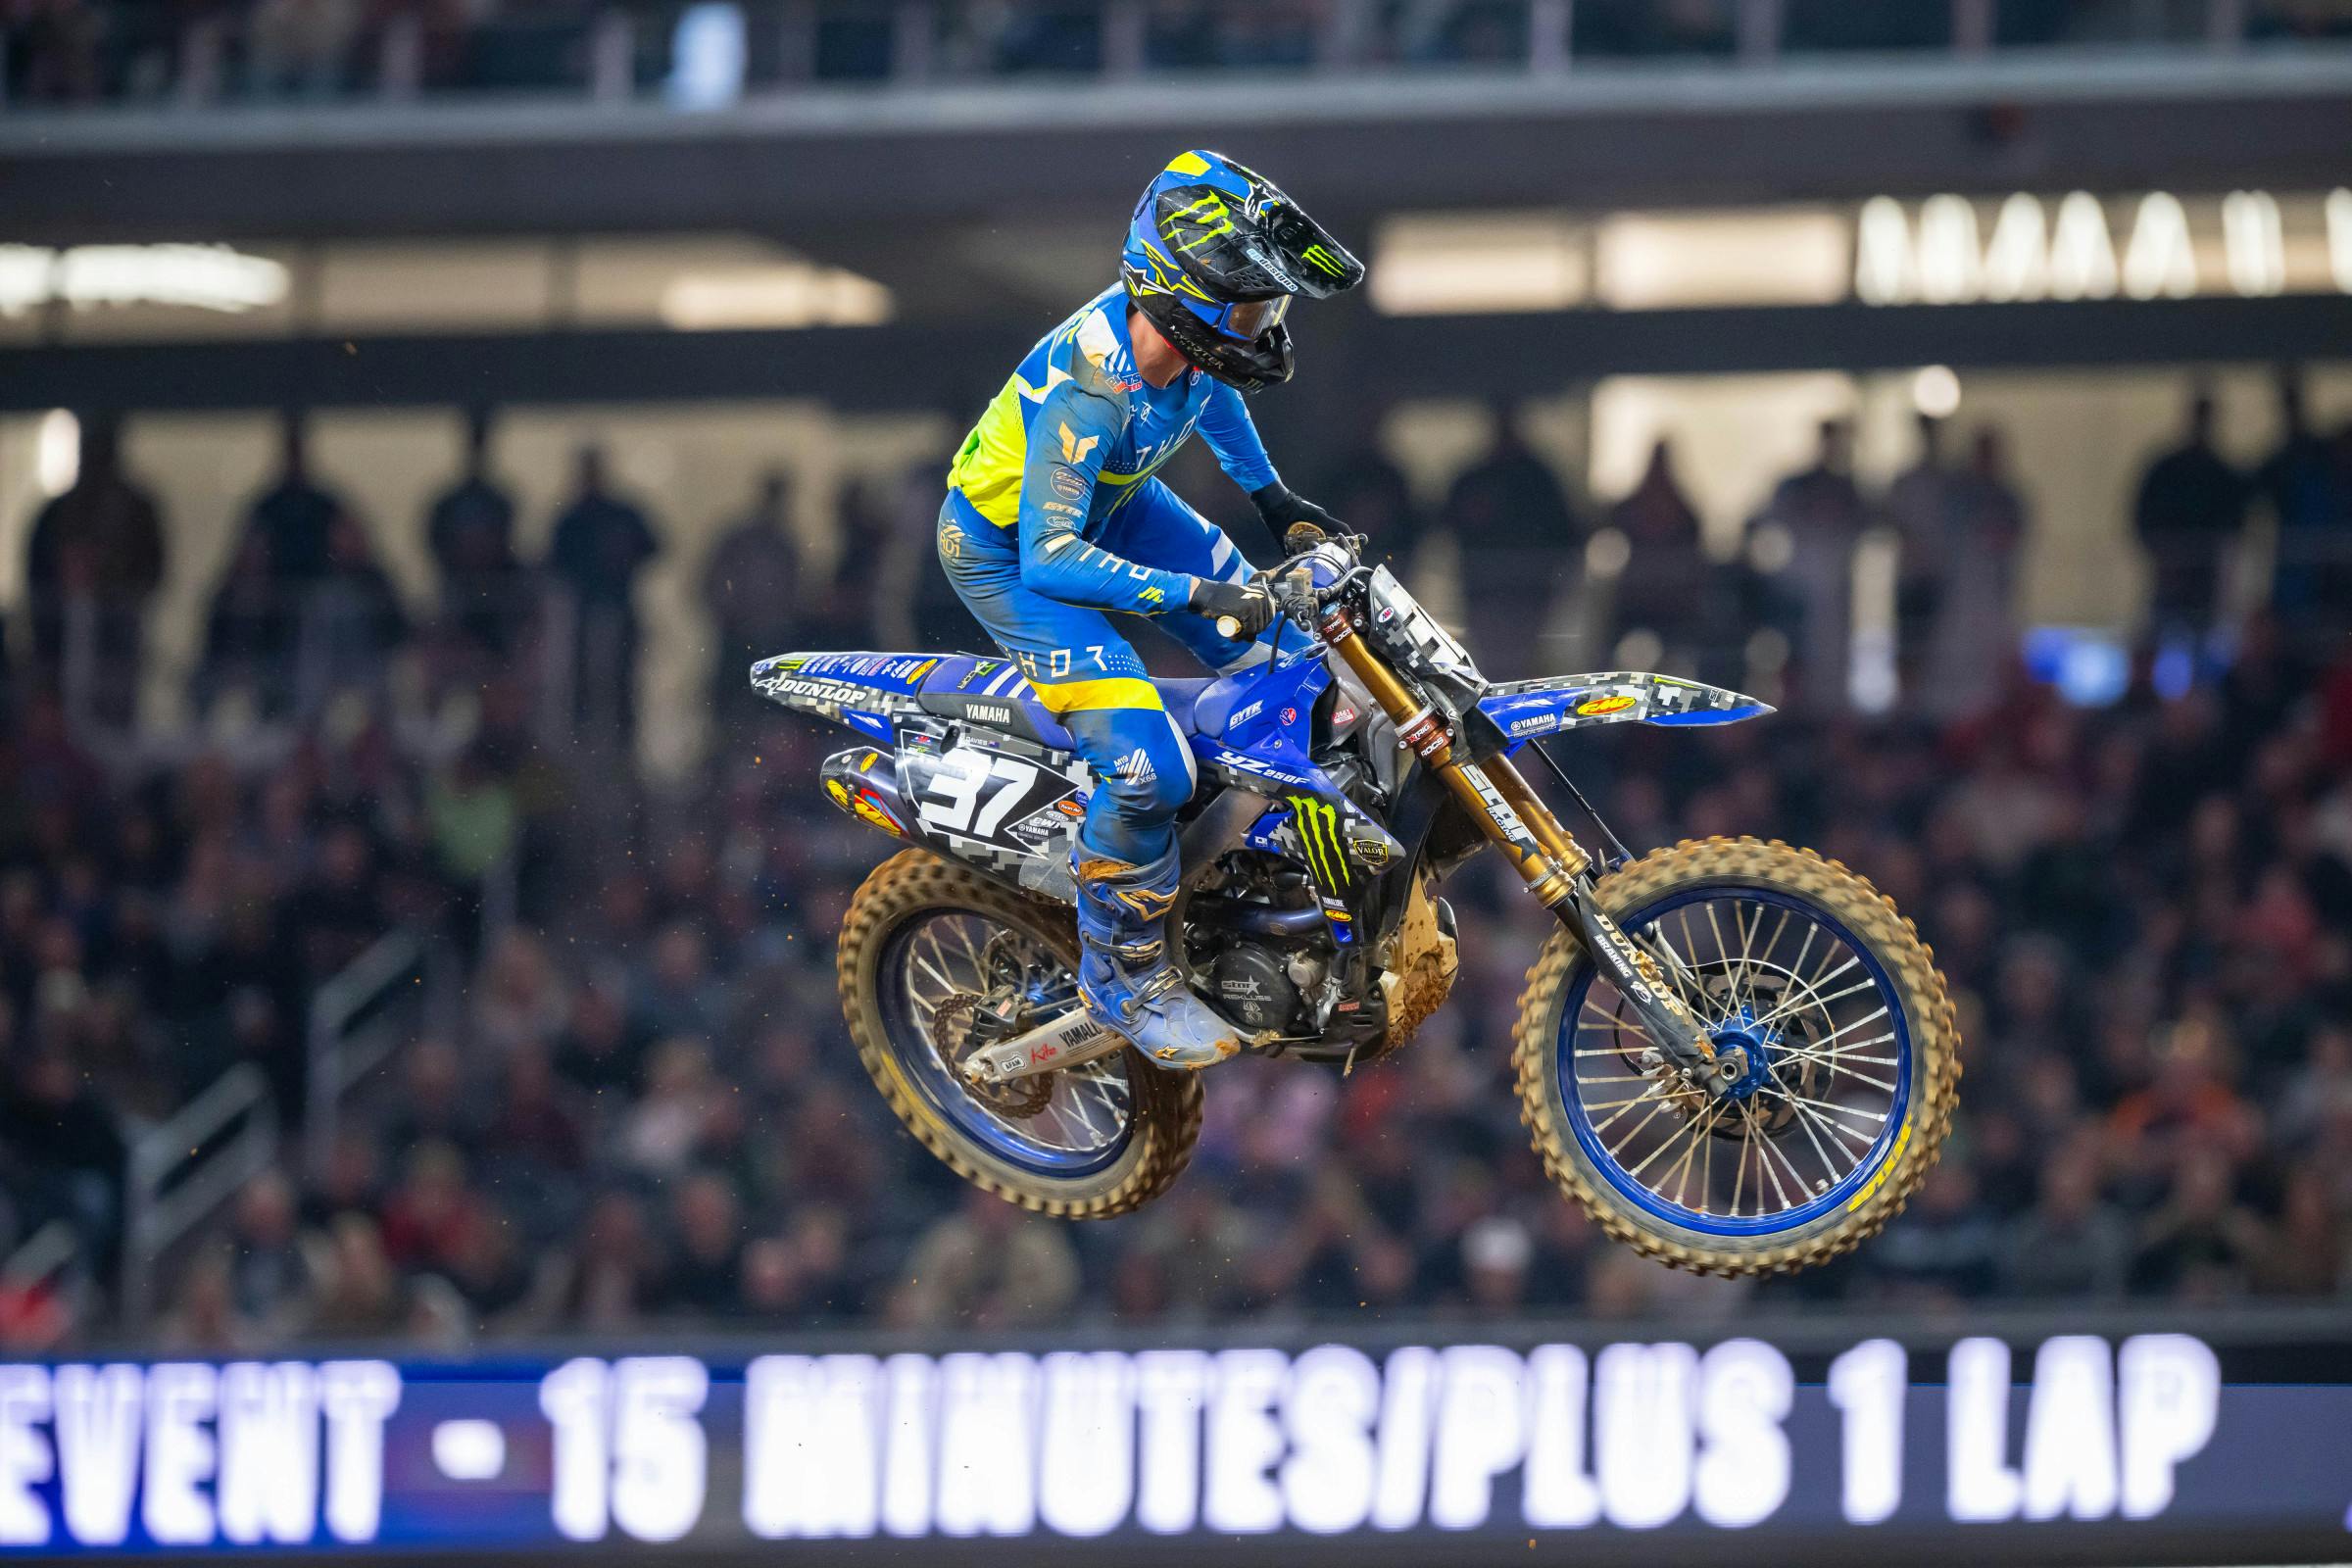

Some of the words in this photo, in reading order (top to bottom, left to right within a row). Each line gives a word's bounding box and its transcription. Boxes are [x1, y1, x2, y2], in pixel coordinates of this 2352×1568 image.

[1246, 249, 1298, 292] apdesigns
[777, 679, 867, 705] DUNLOP
[965, 704, 1010, 723] YAMAHA
[1230, 700, 1264, 727] GYTR
[1579, 697, 1635, 714] FMF
[1520, 713, 1556, 728] YAMAHA
[1406, 723, 1431, 743] XTRIG
[1421, 737, 1445, 757] ROCS
[920, 748, 1039, 838] 37
[1025, 825, 1049, 837] YAMAHA
[1486, 807, 1517, 843] RACING
[1357, 846, 1386, 858] VALOR
[1593, 933, 1634, 979] BRAKING
[1005, 1058, 1021, 1070] AFAM
[1031, 1043, 1056, 1065] Kite
[0, 1360, 402, 1546] EVENT
[539, 1356, 709, 1543] 15
[1828, 1339, 1907, 1525] 1
[1946, 1334, 2221, 1522] LAP
